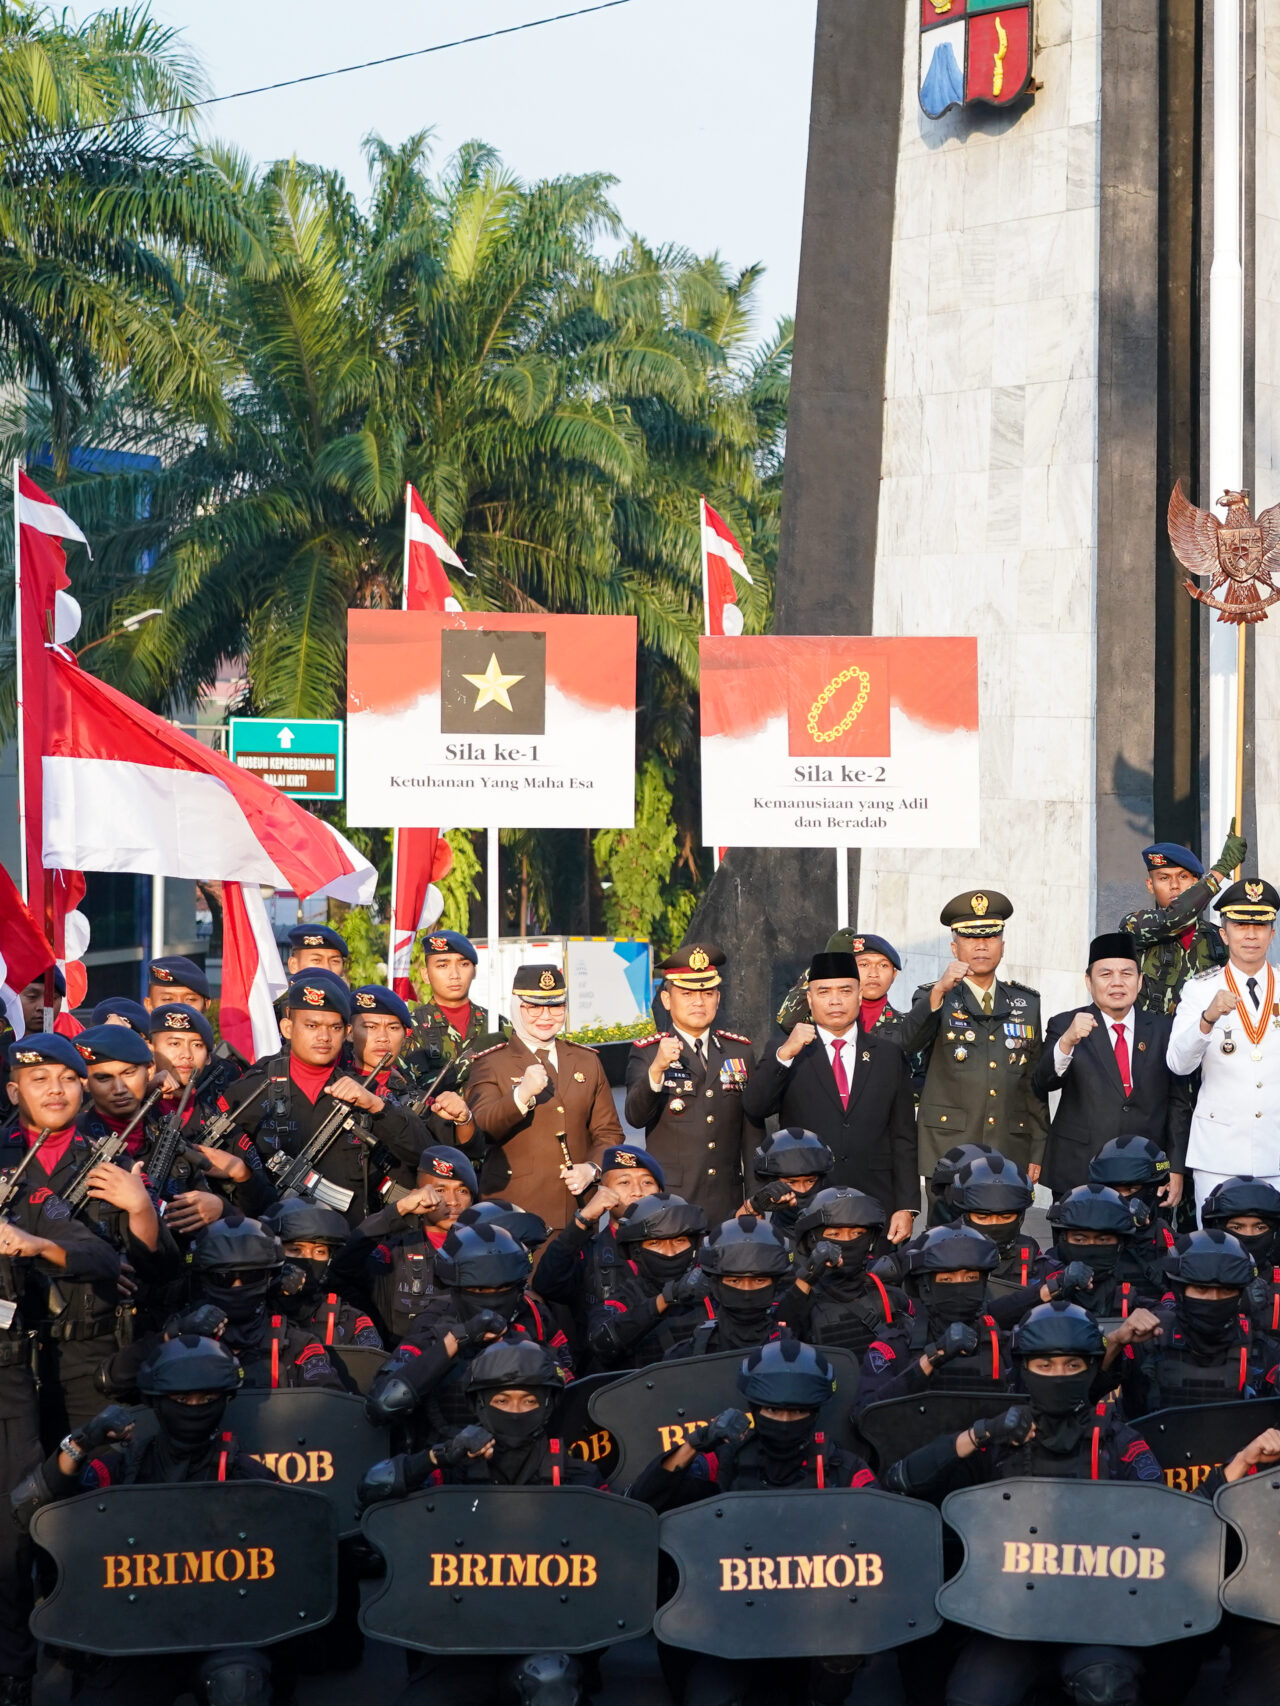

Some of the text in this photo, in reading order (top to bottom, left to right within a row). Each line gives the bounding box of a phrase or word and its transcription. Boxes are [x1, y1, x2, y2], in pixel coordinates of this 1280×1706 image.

[445, 742, 538, 762] Sila ke-1
[269, 757, 326, 771] KEPRESIDENAN
[326, 758, 335, 771] RI
[794, 764, 886, 783] Sila ke-2
[390, 775, 594, 792] Ketuhanan Yang Maha Esa
[753, 797, 929, 813] Kemanusiaan yang Adil
[794, 815, 888, 828] dan Beradab
[103, 1547, 275, 1588] BRIMOB
[1002, 1540, 1165, 1579] BRIMOB
[429, 1553, 598, 1587] BRIMOB
[719, 1553, 884, 1592] BRIMOB
